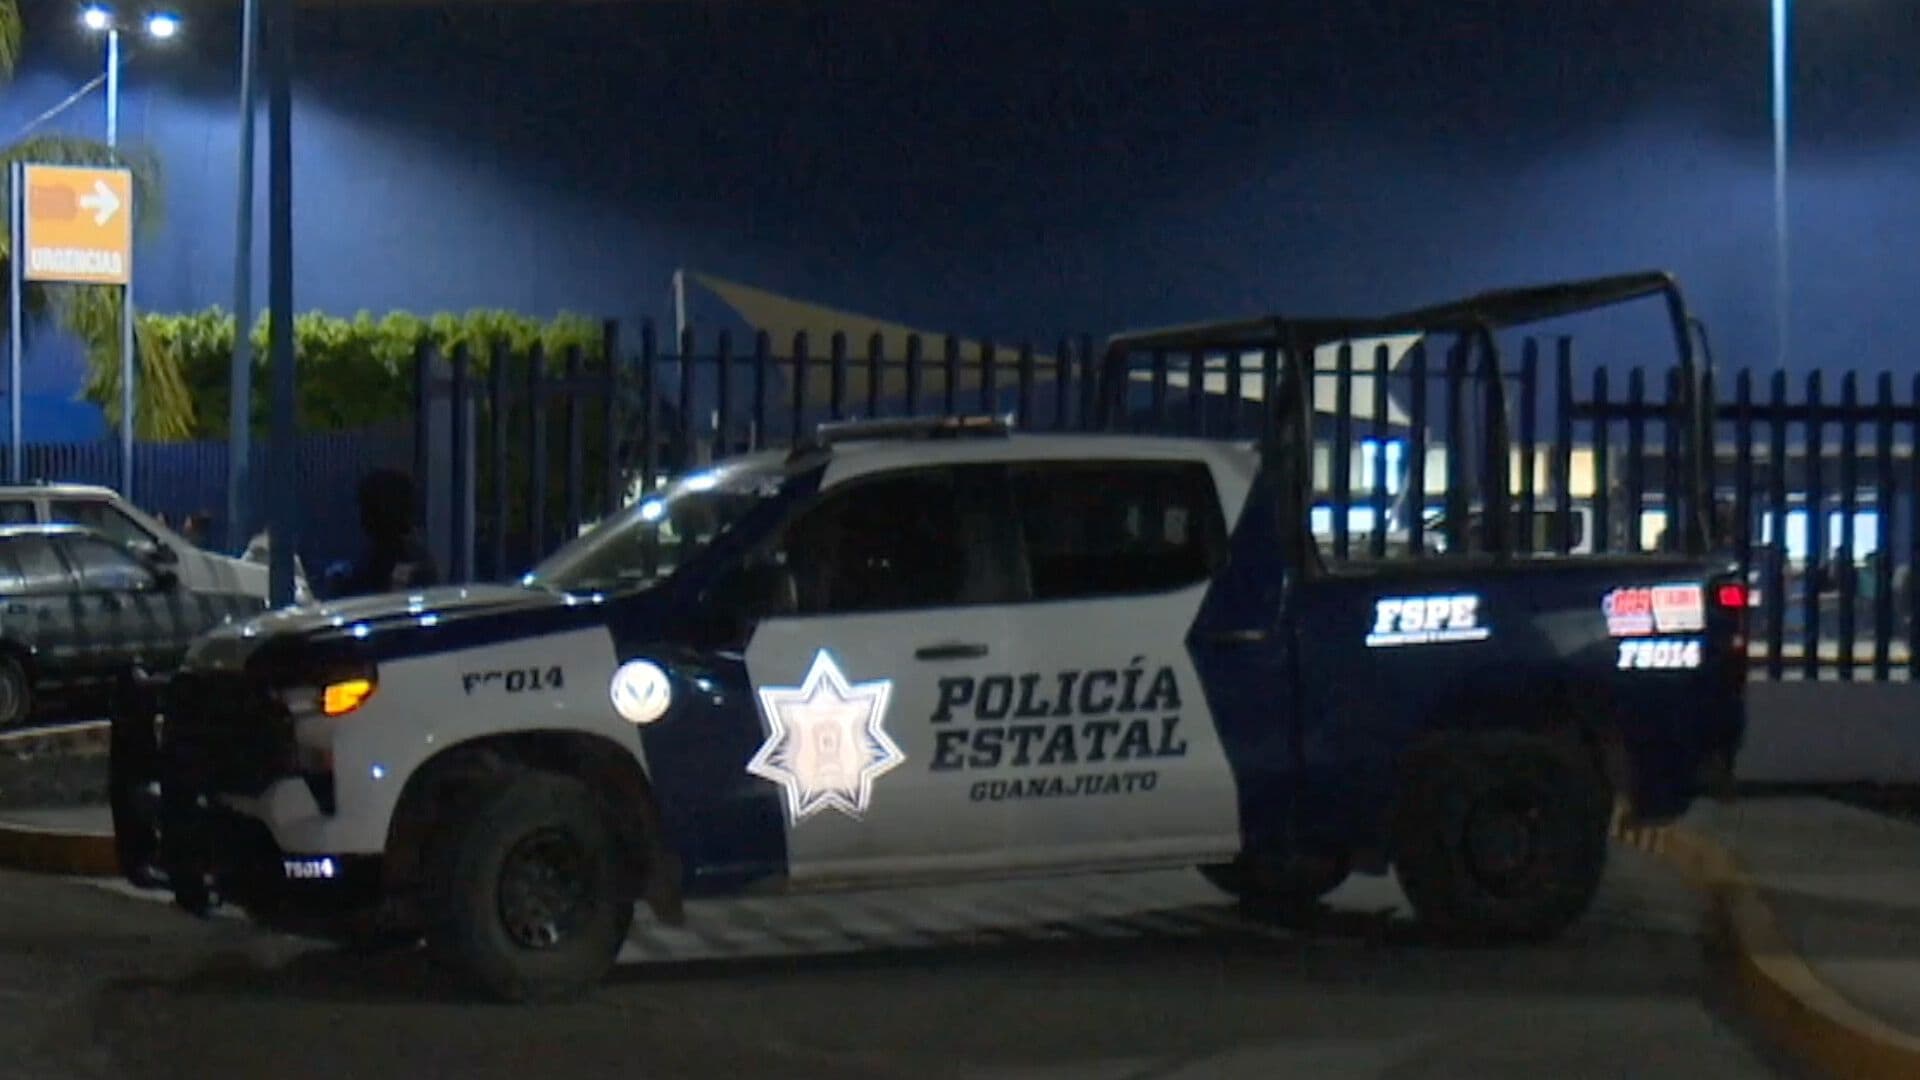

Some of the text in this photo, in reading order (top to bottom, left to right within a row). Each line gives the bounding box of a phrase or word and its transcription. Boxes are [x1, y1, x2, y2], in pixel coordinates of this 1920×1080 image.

[1374, 596, 1477, 632] FSPE
[1617, 640, 1700, 668] FS014
[930, 655, 1182, 723] POLICÍA
[929, 715, 1187, 771] ESTATAL
[969, 770, 1158, 801] GUANAJUATO
